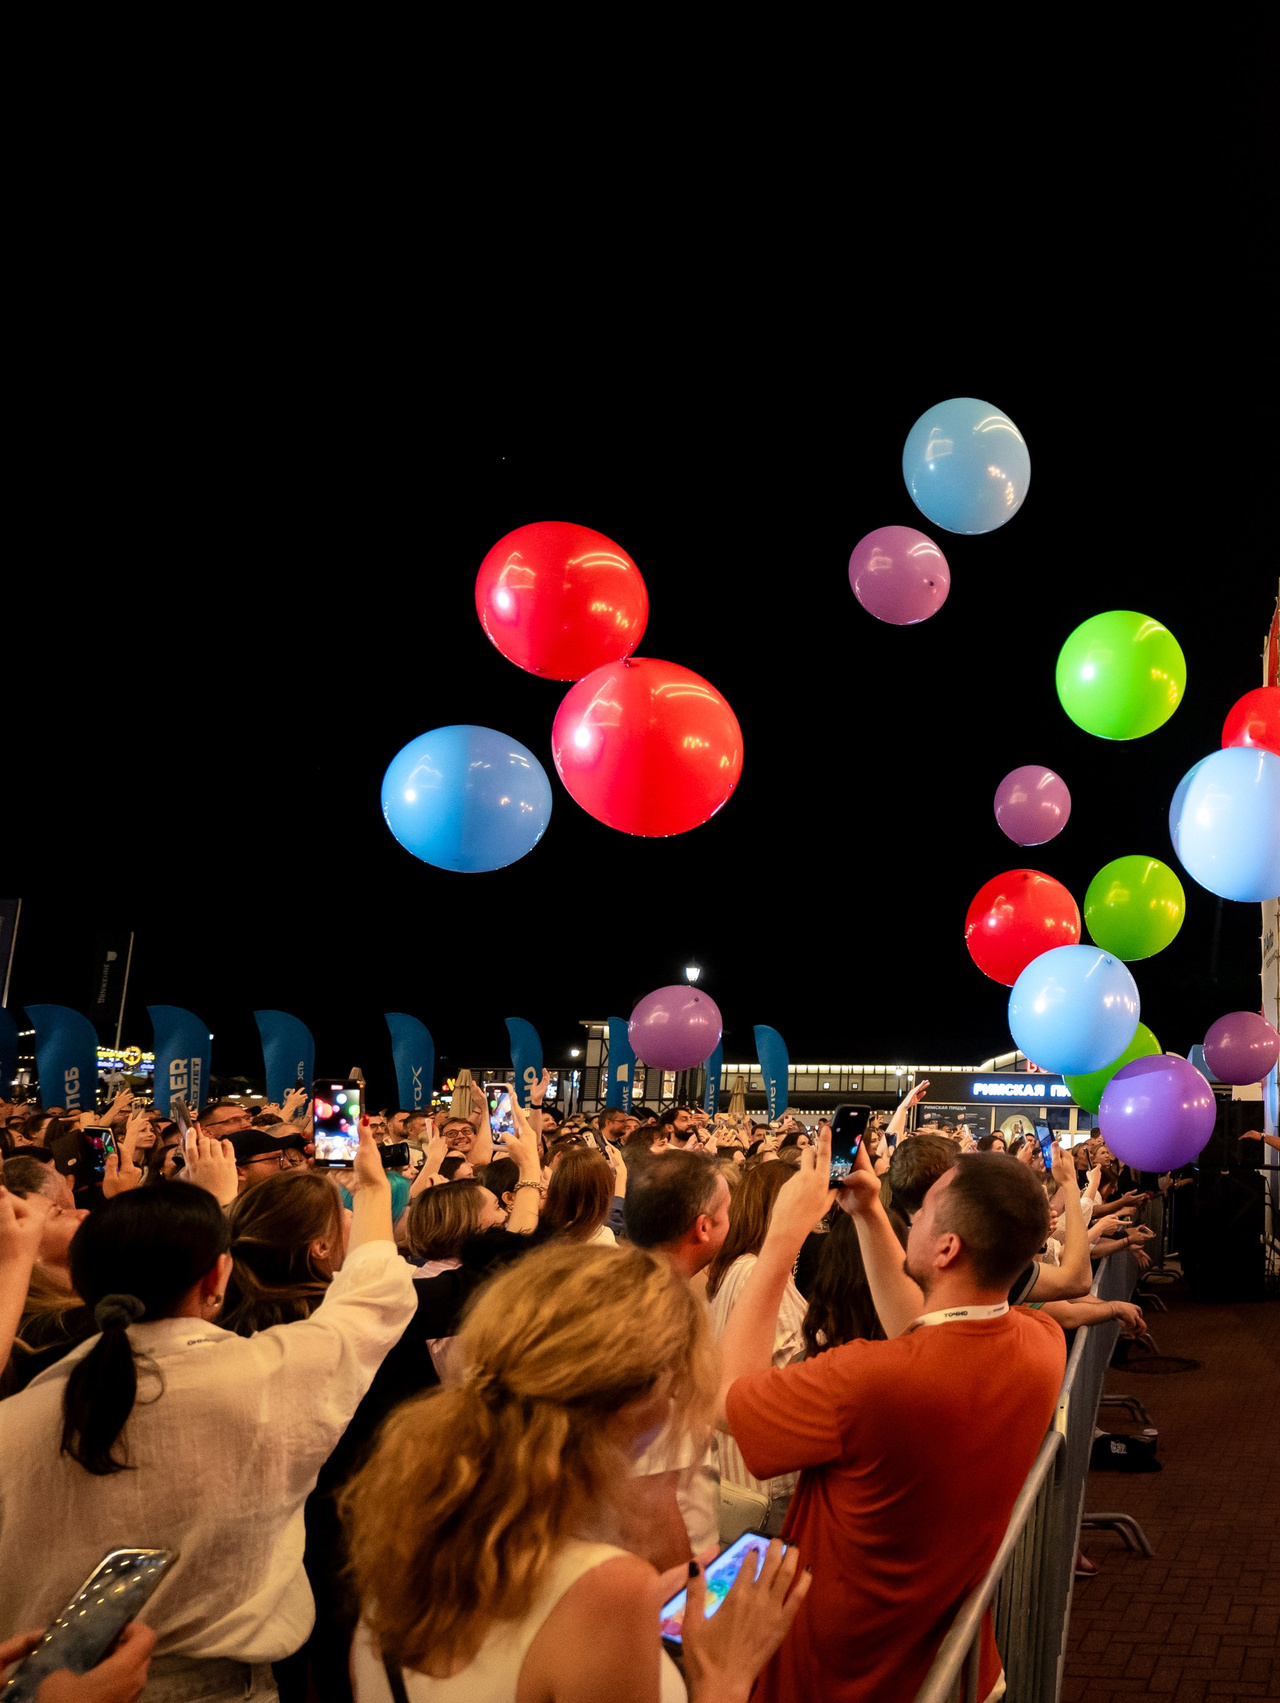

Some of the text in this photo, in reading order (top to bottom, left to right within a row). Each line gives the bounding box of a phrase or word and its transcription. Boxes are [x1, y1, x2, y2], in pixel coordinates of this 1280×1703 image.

[64, 1066, 81, 1110] ПСБ
[169, 1058, 188, 1107] AER
[972, 1082, 1046, 1097] РИМСКАЯ
